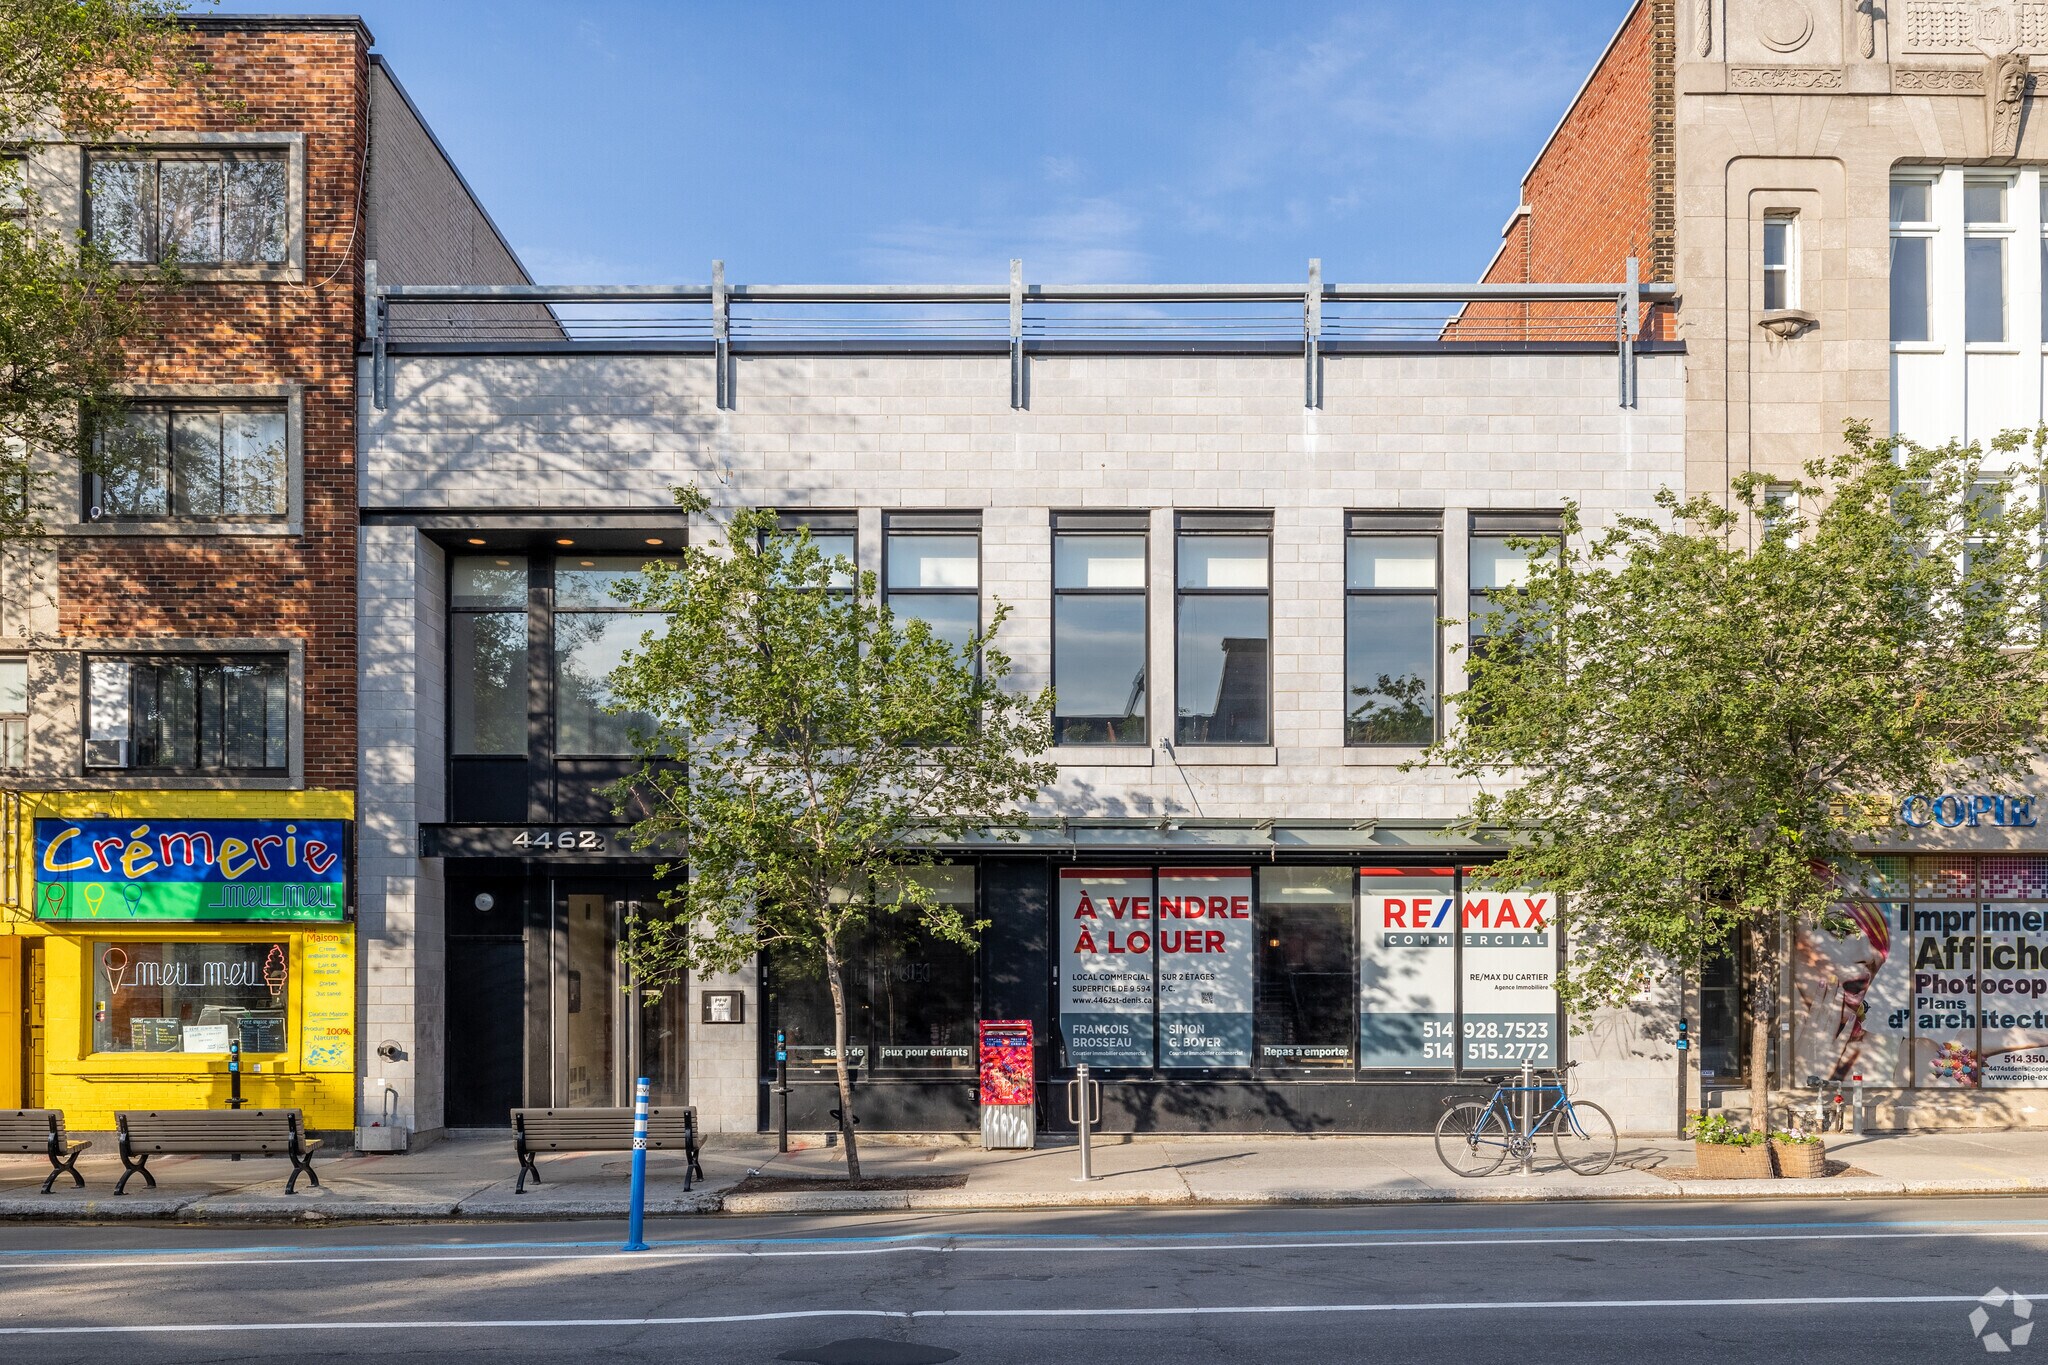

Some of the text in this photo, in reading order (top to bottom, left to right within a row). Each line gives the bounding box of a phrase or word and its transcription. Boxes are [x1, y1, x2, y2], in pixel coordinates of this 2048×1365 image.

[1902, 795, 2038, 828] COPIE
[512, 830, 597, 849] 4462
[43, 824, 337, 879] Crémerie
[1074, 889, 1250, 919] À VENDRE
[271, 907, 336, 917] Glacier
[1384, 898, 1549, 928] RE/MAX
[306, 933, 339, 943] Maison
[1074, 924, 1226, 954] À LOUER
[1388, 935, 1545, 945] COMMERCIAL
[1072, 971, 1216, 981] LOCAL COMMERCIAL SUR 2 ÉTAGES
[1469, 973, 1549, 981] RE/MAX DU CARTIER
[1072, 985, 1176, 993] SUPERFICIE DE 9 594 P.C.
[1494, 984, 1516, 992] Agence
[1072, 996, 1152, 1005] www.4462st-denis.ca
[1917, 997, 1967, 1010] Plans
[1072, 1024, 1129, 1036] FRANÇOIS
[1168, 1024, 1205, 1034] SIMON
[1423, 1021, 1549, 1039] 514 928.7523
[1072, 1037, 1132, 1048] BROSSEAU
[1169, 1037, 1221, 1048] G. BOYER
[823, 1047, 968, 1059] Sae de jeux pour enfants
[1263, 1046, 1349, 1058] Repas à emporter
[1423, 1042, 1549, 1060] 514 515.2772
